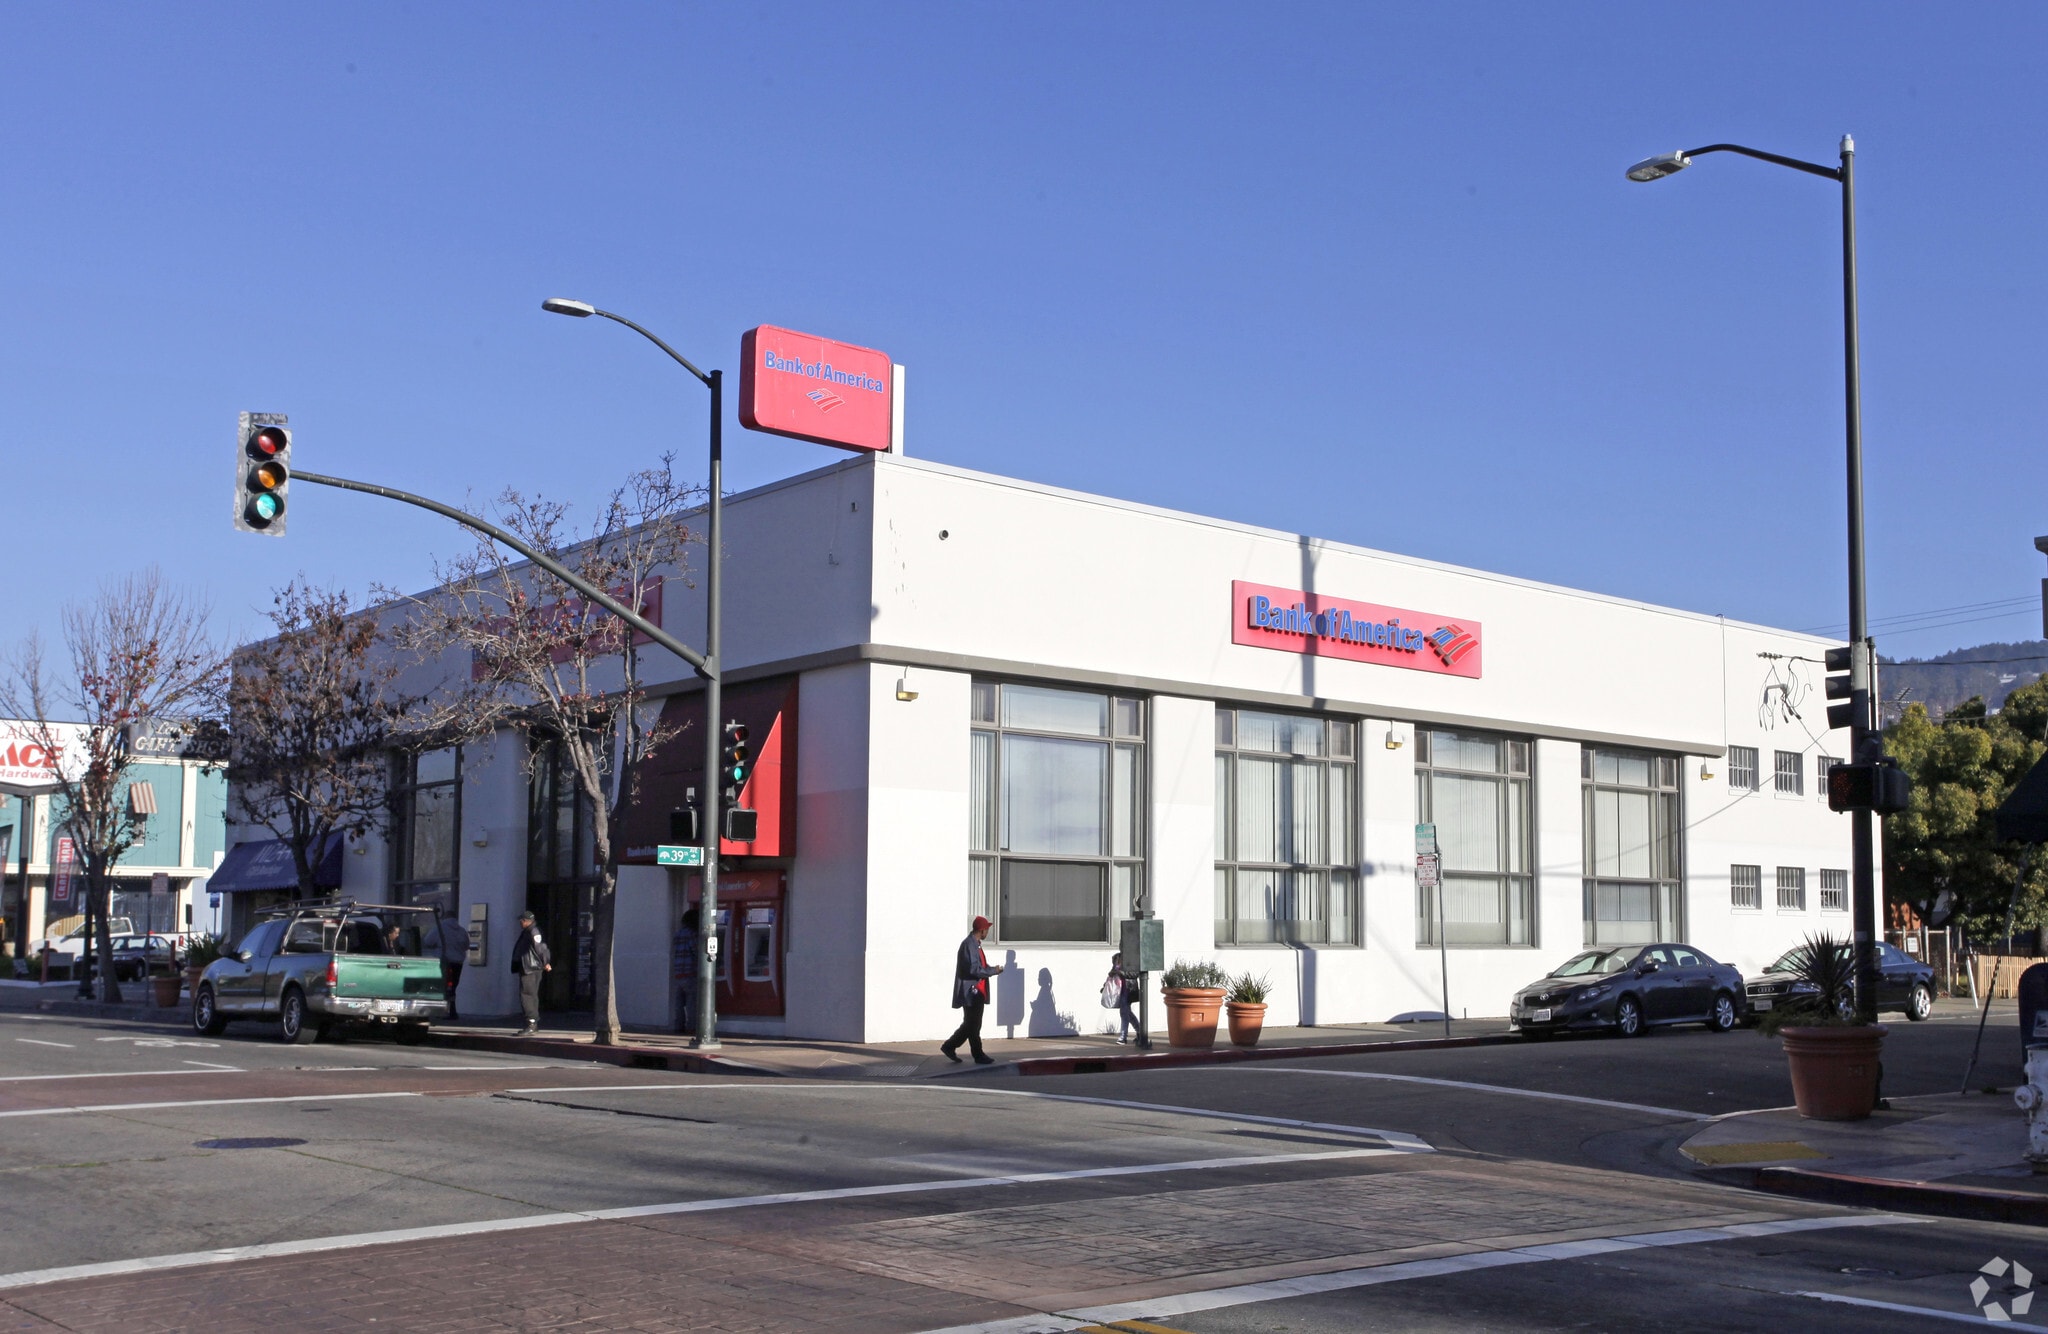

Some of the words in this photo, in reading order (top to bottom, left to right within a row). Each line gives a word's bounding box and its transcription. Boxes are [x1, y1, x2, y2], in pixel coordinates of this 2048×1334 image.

[765, 351, 803, 375] Bank
[806, 362, 821, 380] of
[823, 365, 883, 393] America
[1254, 595, 1312, 633] Bank
[1315, 607, 1337, 637] of
[1340, 610, 1425, 651] America
